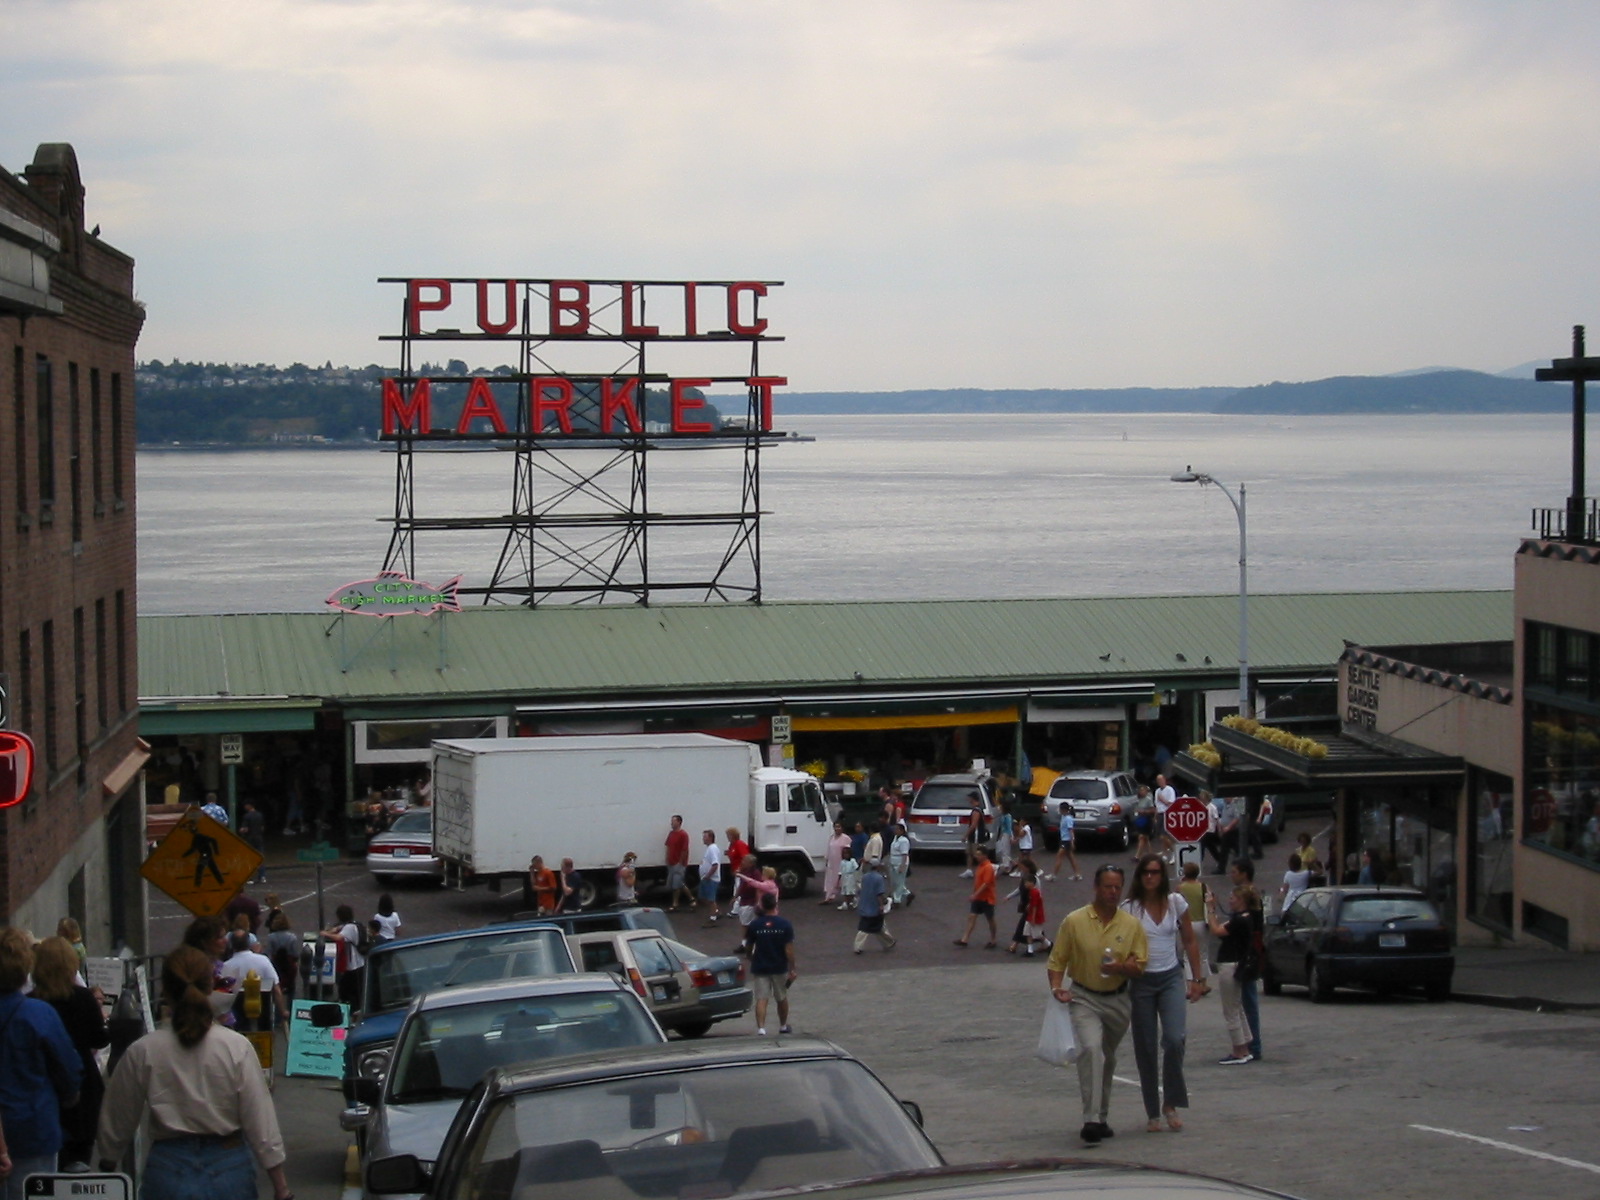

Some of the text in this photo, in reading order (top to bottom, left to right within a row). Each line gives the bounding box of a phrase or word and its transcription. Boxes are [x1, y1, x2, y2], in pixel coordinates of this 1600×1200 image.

[409, 279, 768, 335] PUBLIC
[381, 376, 788, 434] MARKET
[374, 583, 414, 593] CITY
[341, 594, 446, 605] FISH MARKET
[1348, 663, 1380, 691] SEATTLE
[1348, 685, 1379, 712] GARDEN
[774, 717, 789, 725] ONE
[1347, 705, 1377, 731] CENTER
[223, 735, 241, 744] ONE
[223, 744, 240, 752] WAY
[1168, 811, 1206, 828] STOP
[36, 1179, 44, 1191] 3
